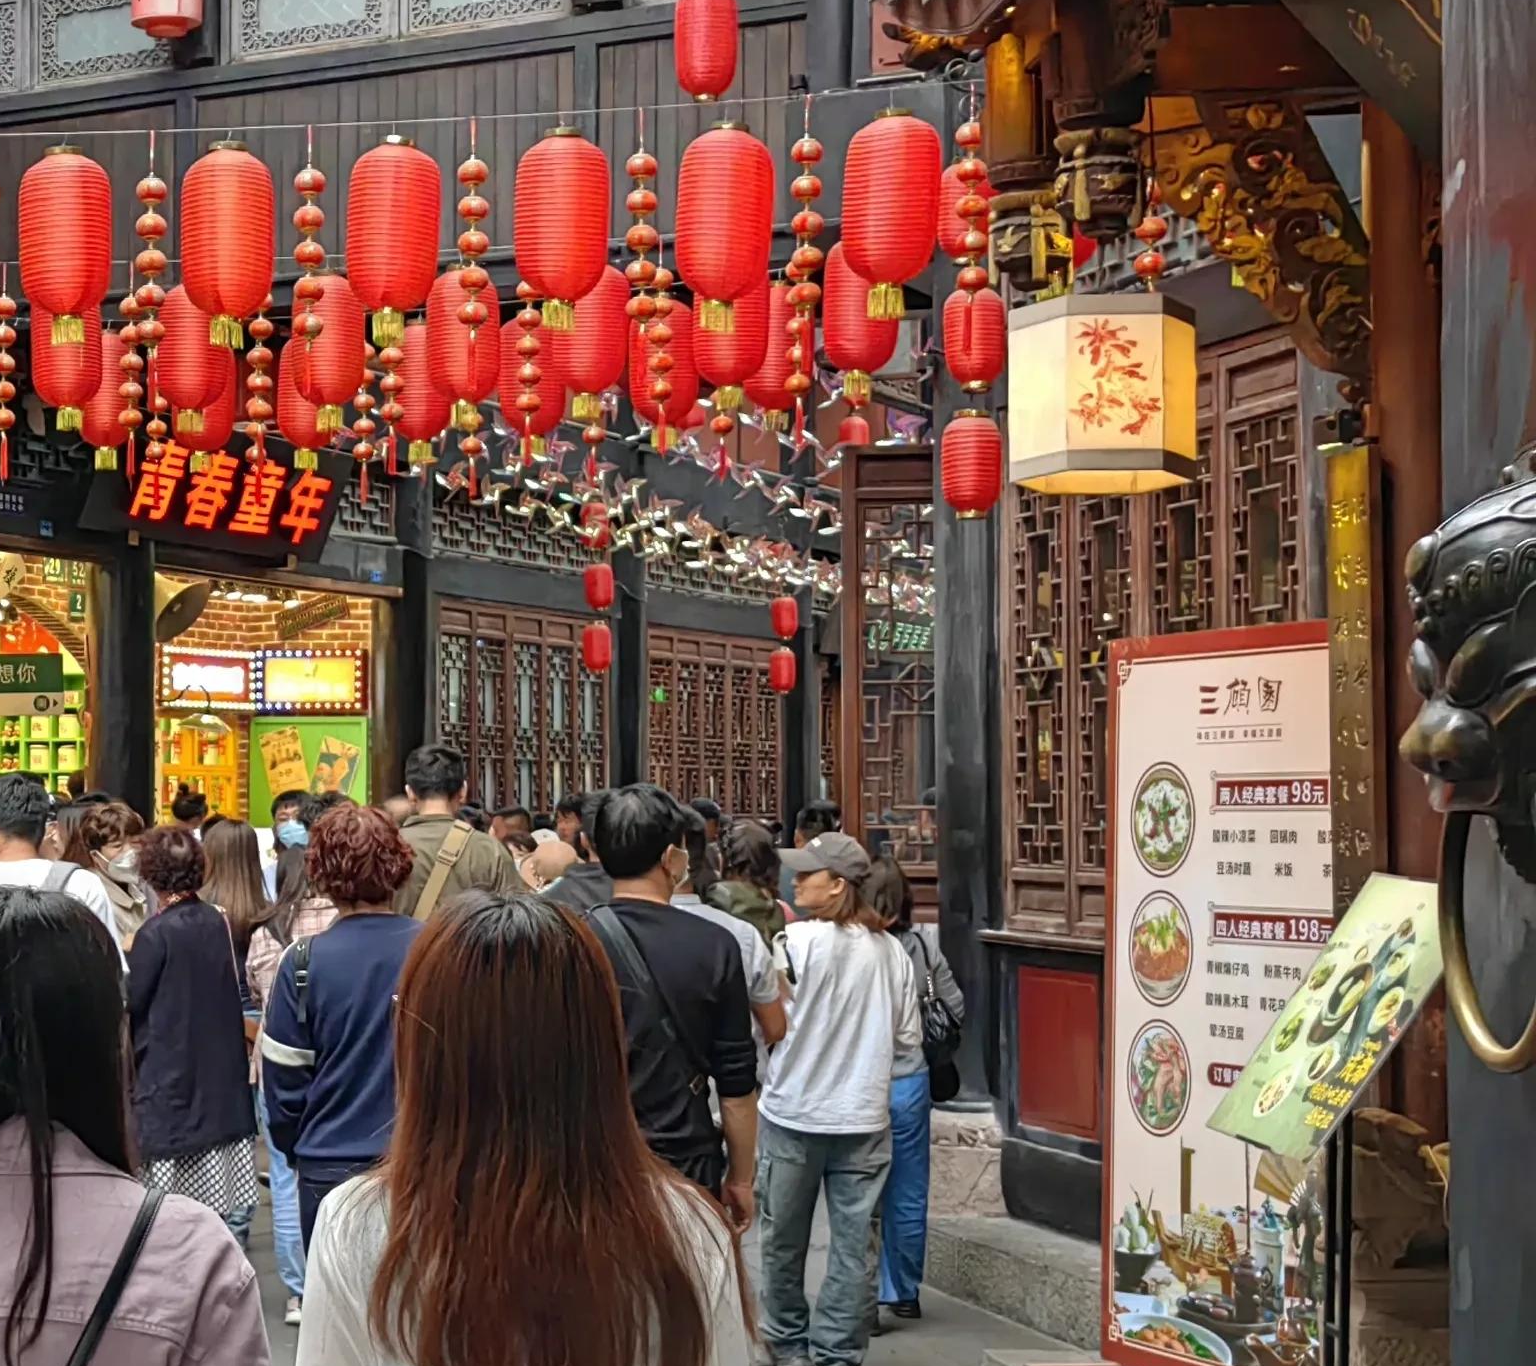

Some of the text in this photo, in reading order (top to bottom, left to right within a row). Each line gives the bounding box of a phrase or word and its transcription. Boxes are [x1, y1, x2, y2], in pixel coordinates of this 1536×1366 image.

[128, 438, 333, 544] 青春童年
[1219, 781, 1325, 805] 两人经典套餐 98元
[1274, 862, 1293, 877] 米饭
[1216, 919, 1332, 942] 四人经典套餐 198元
[1264, 964, 1302, 981] 粉蒸牛肉
